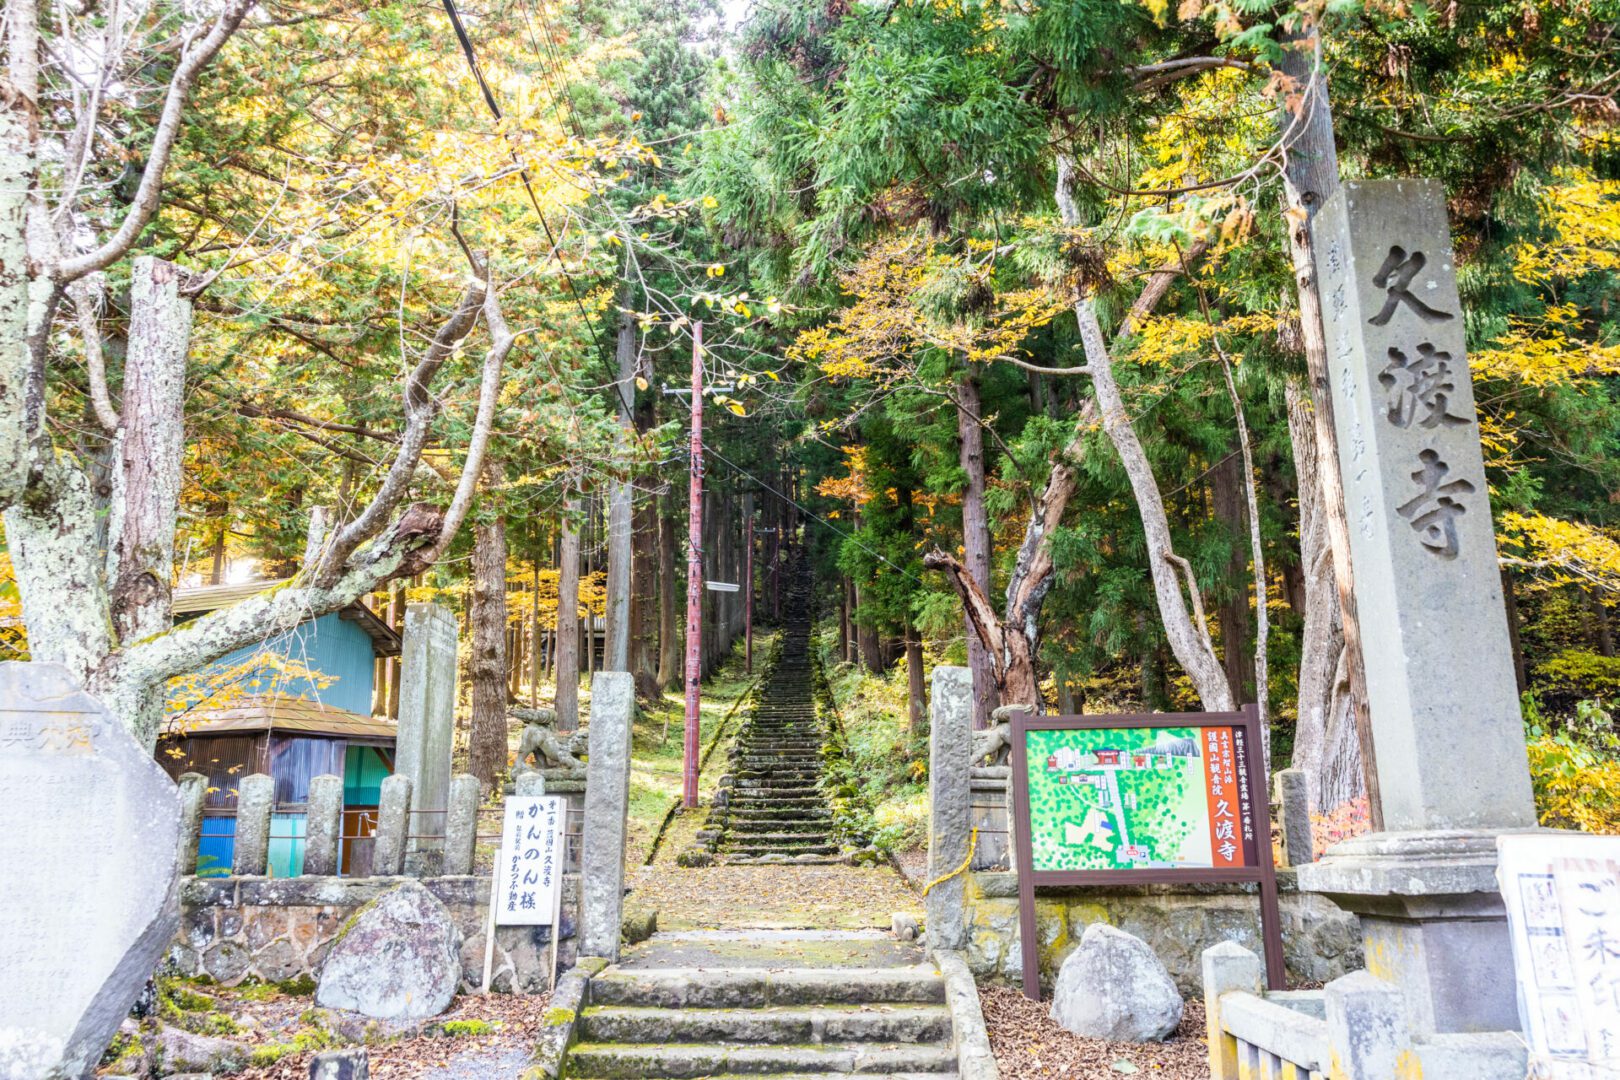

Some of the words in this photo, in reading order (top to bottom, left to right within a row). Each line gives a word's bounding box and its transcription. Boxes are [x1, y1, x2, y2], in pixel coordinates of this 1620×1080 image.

[1367, 244, 1476, 562] 久渡寺
[520, 803, 544, 910] かんのん様
[1214, 799, 1237, 862] 久渡寺
